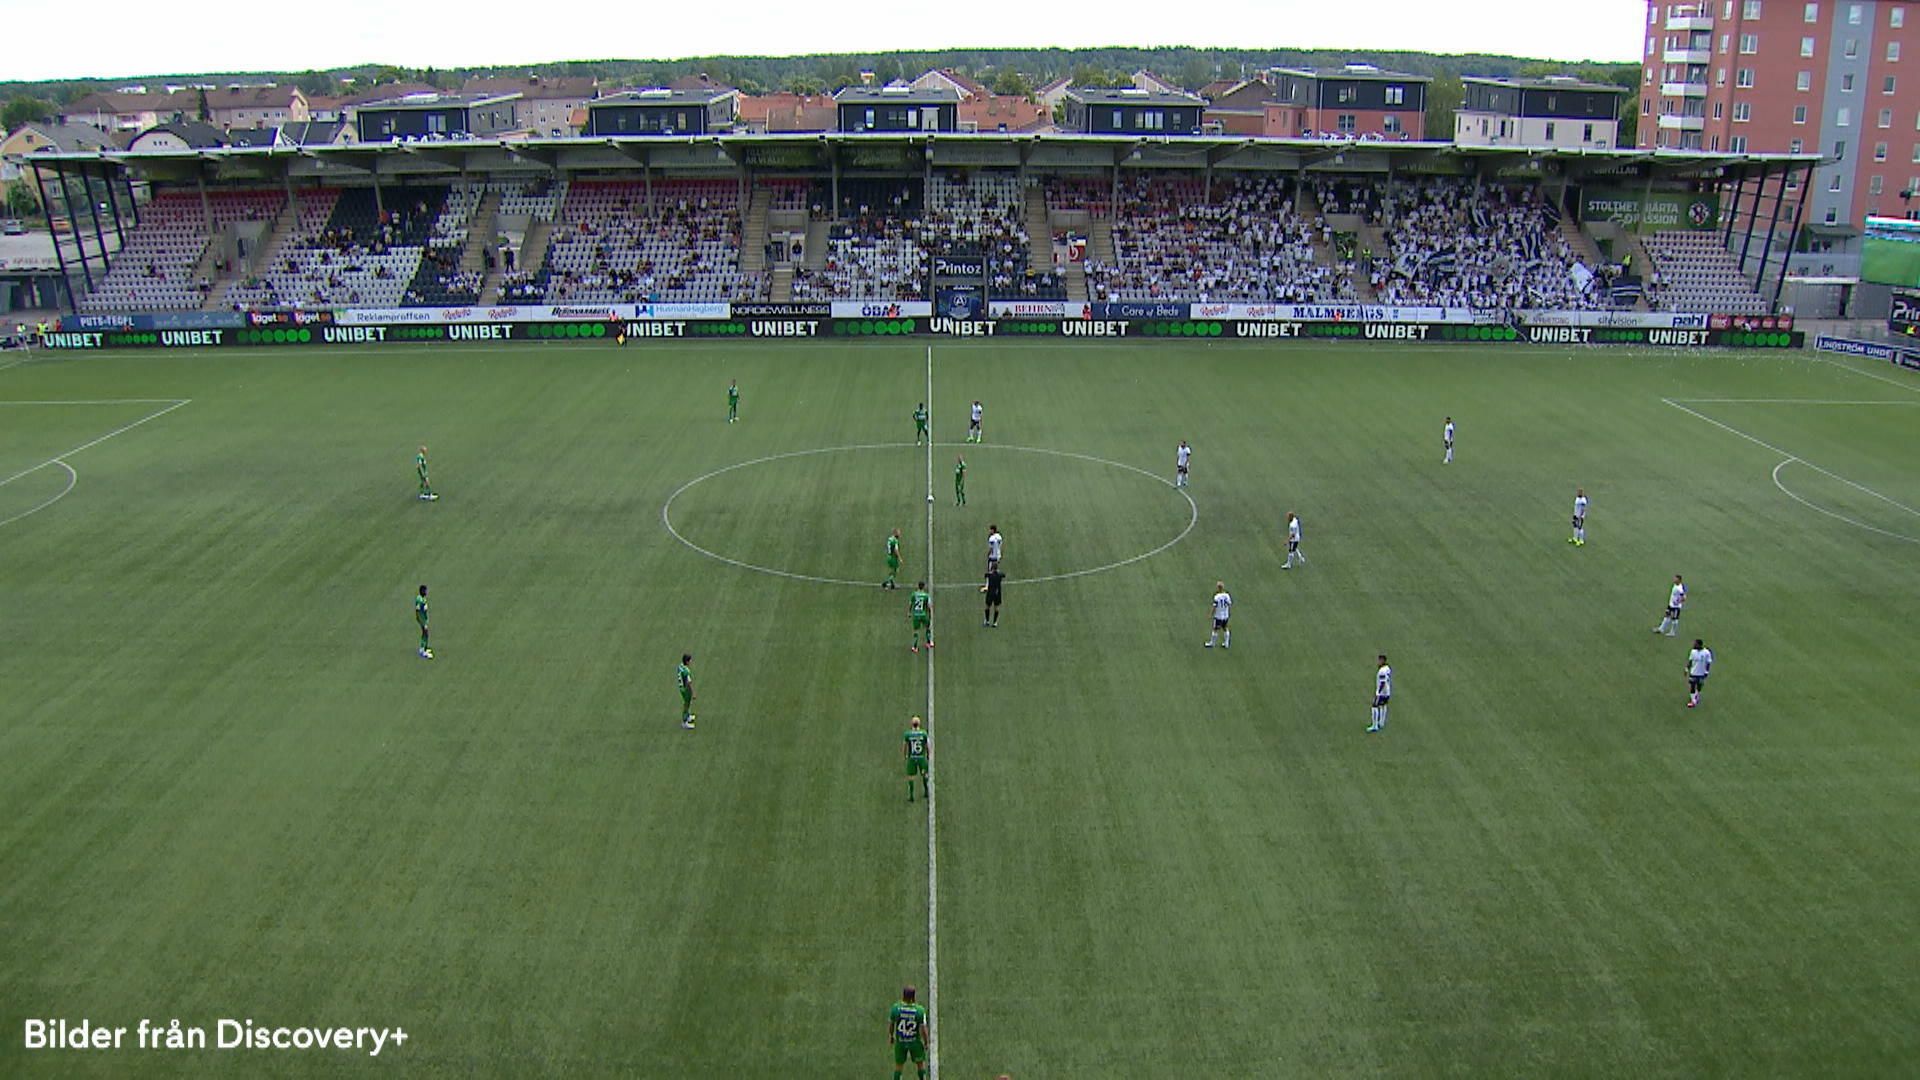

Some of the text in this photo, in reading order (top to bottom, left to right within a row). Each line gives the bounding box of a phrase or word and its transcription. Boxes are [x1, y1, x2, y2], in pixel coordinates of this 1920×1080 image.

[1121, 305, 1144, 316] Care
[1156, 304, 1179, 316] Beds
[324, 327, 386, 341] UNIBET
[448, 325, 513, 339] UNIBET
[751, 321, 818, 336] UNIBET
[930, 318, 997, 336] UNIBET
[1062, 321, 1129, 336] UNIBET
[1236, 322, 1303, 337] UNIBET
[1364, 325, 1428, 338] UNIBET
[43, 332, 103, 347] UNIBET
[161, 331, 223, 345] UNIBET
[1530, 328, 1591, 342] UNIBET
[1648, 330, 1710, 344] UNIBET
[911, 740, 922, 754] 16
[897, 1019, 917, 1036] 42
